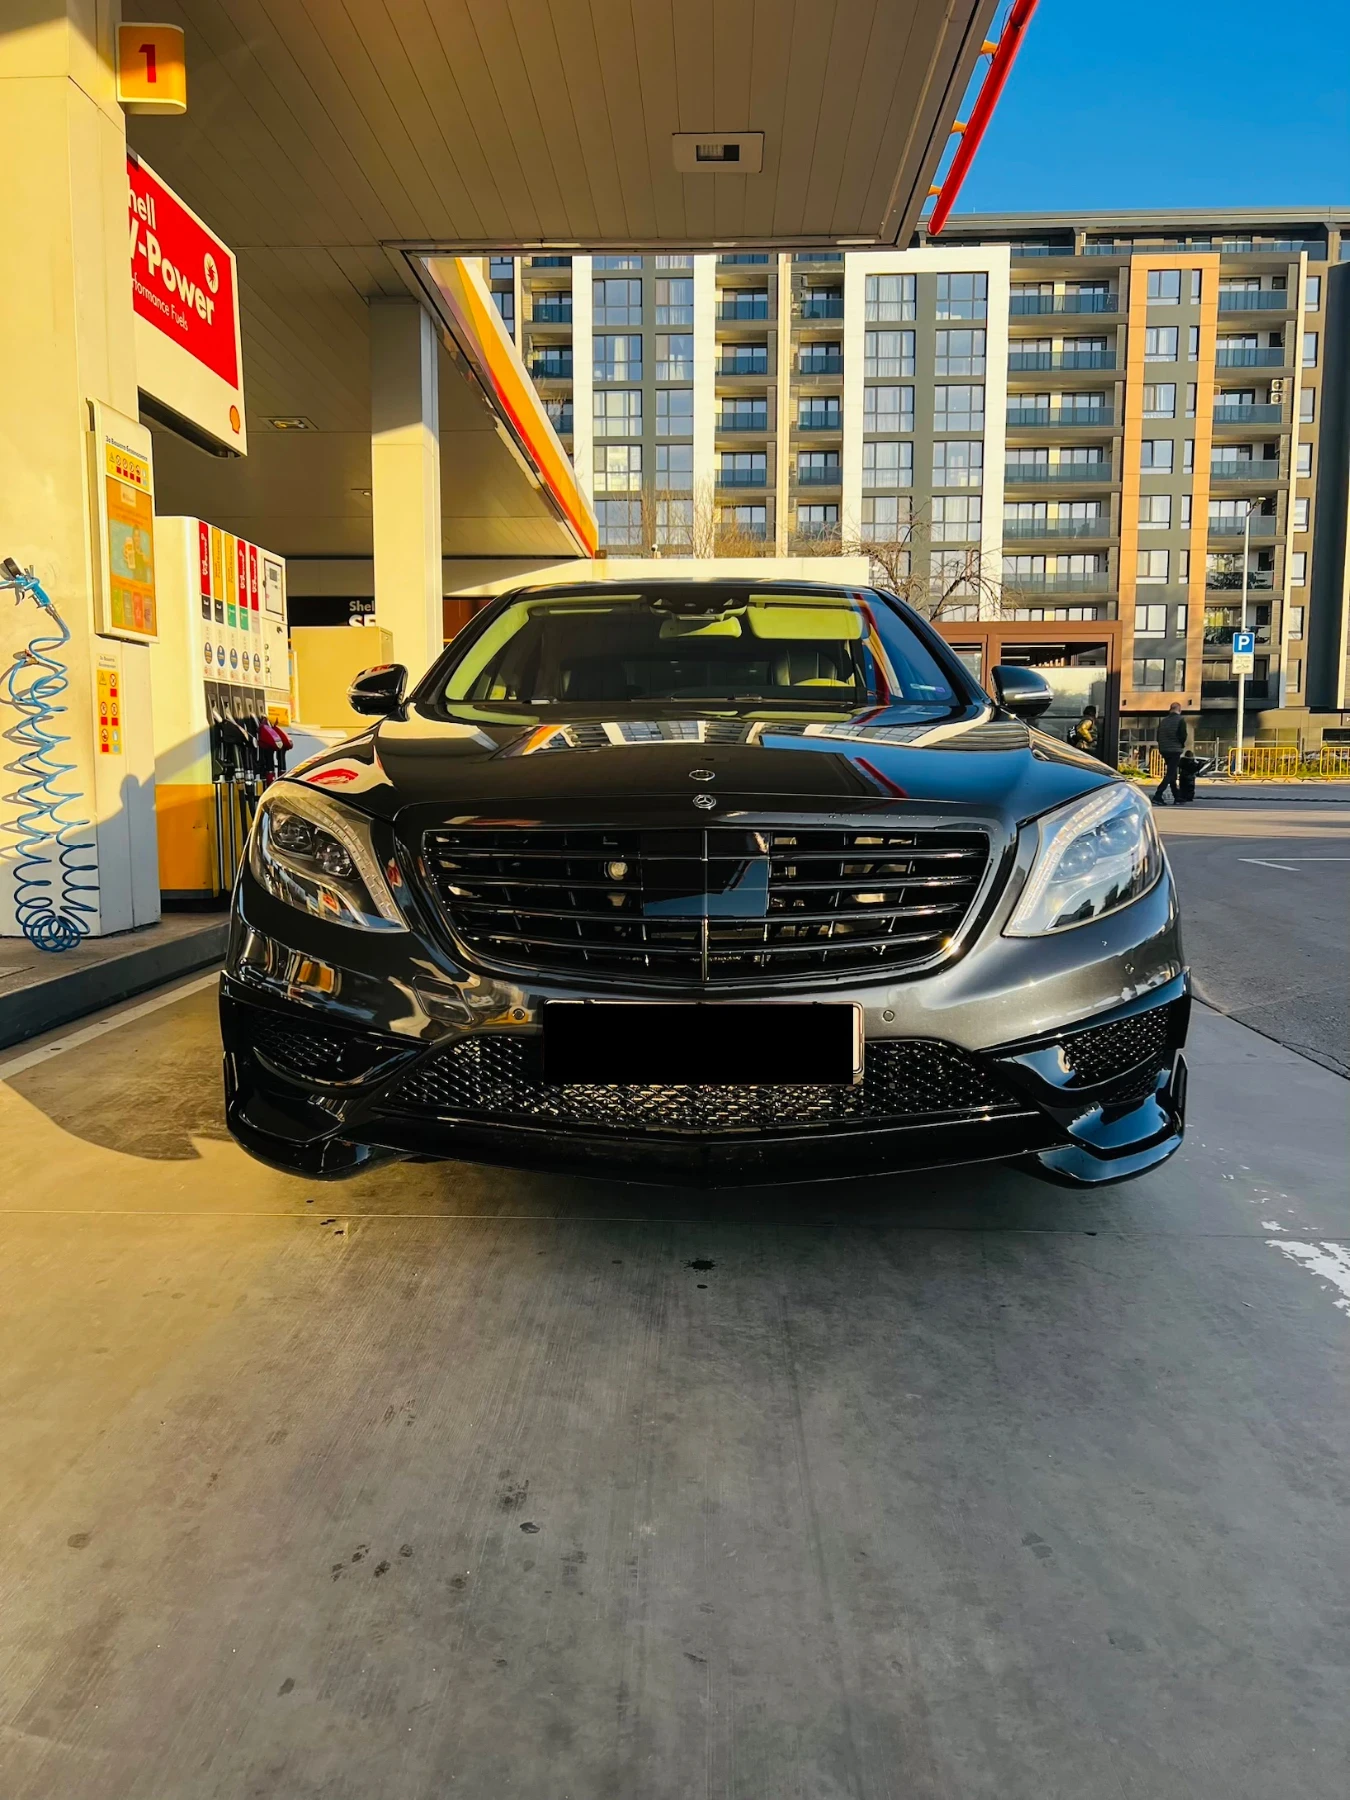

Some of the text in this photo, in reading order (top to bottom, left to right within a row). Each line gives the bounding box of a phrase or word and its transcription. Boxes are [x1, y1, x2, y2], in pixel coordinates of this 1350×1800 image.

[139, 44, 156, 83] 1
[127, 174, 157, 231] hell
[171, 303, 189, 332] Fuels
[349, 600, 375, 612] Shel
[349, 614, 376, 627] SE
[1238, 635, 1250, 651] P
